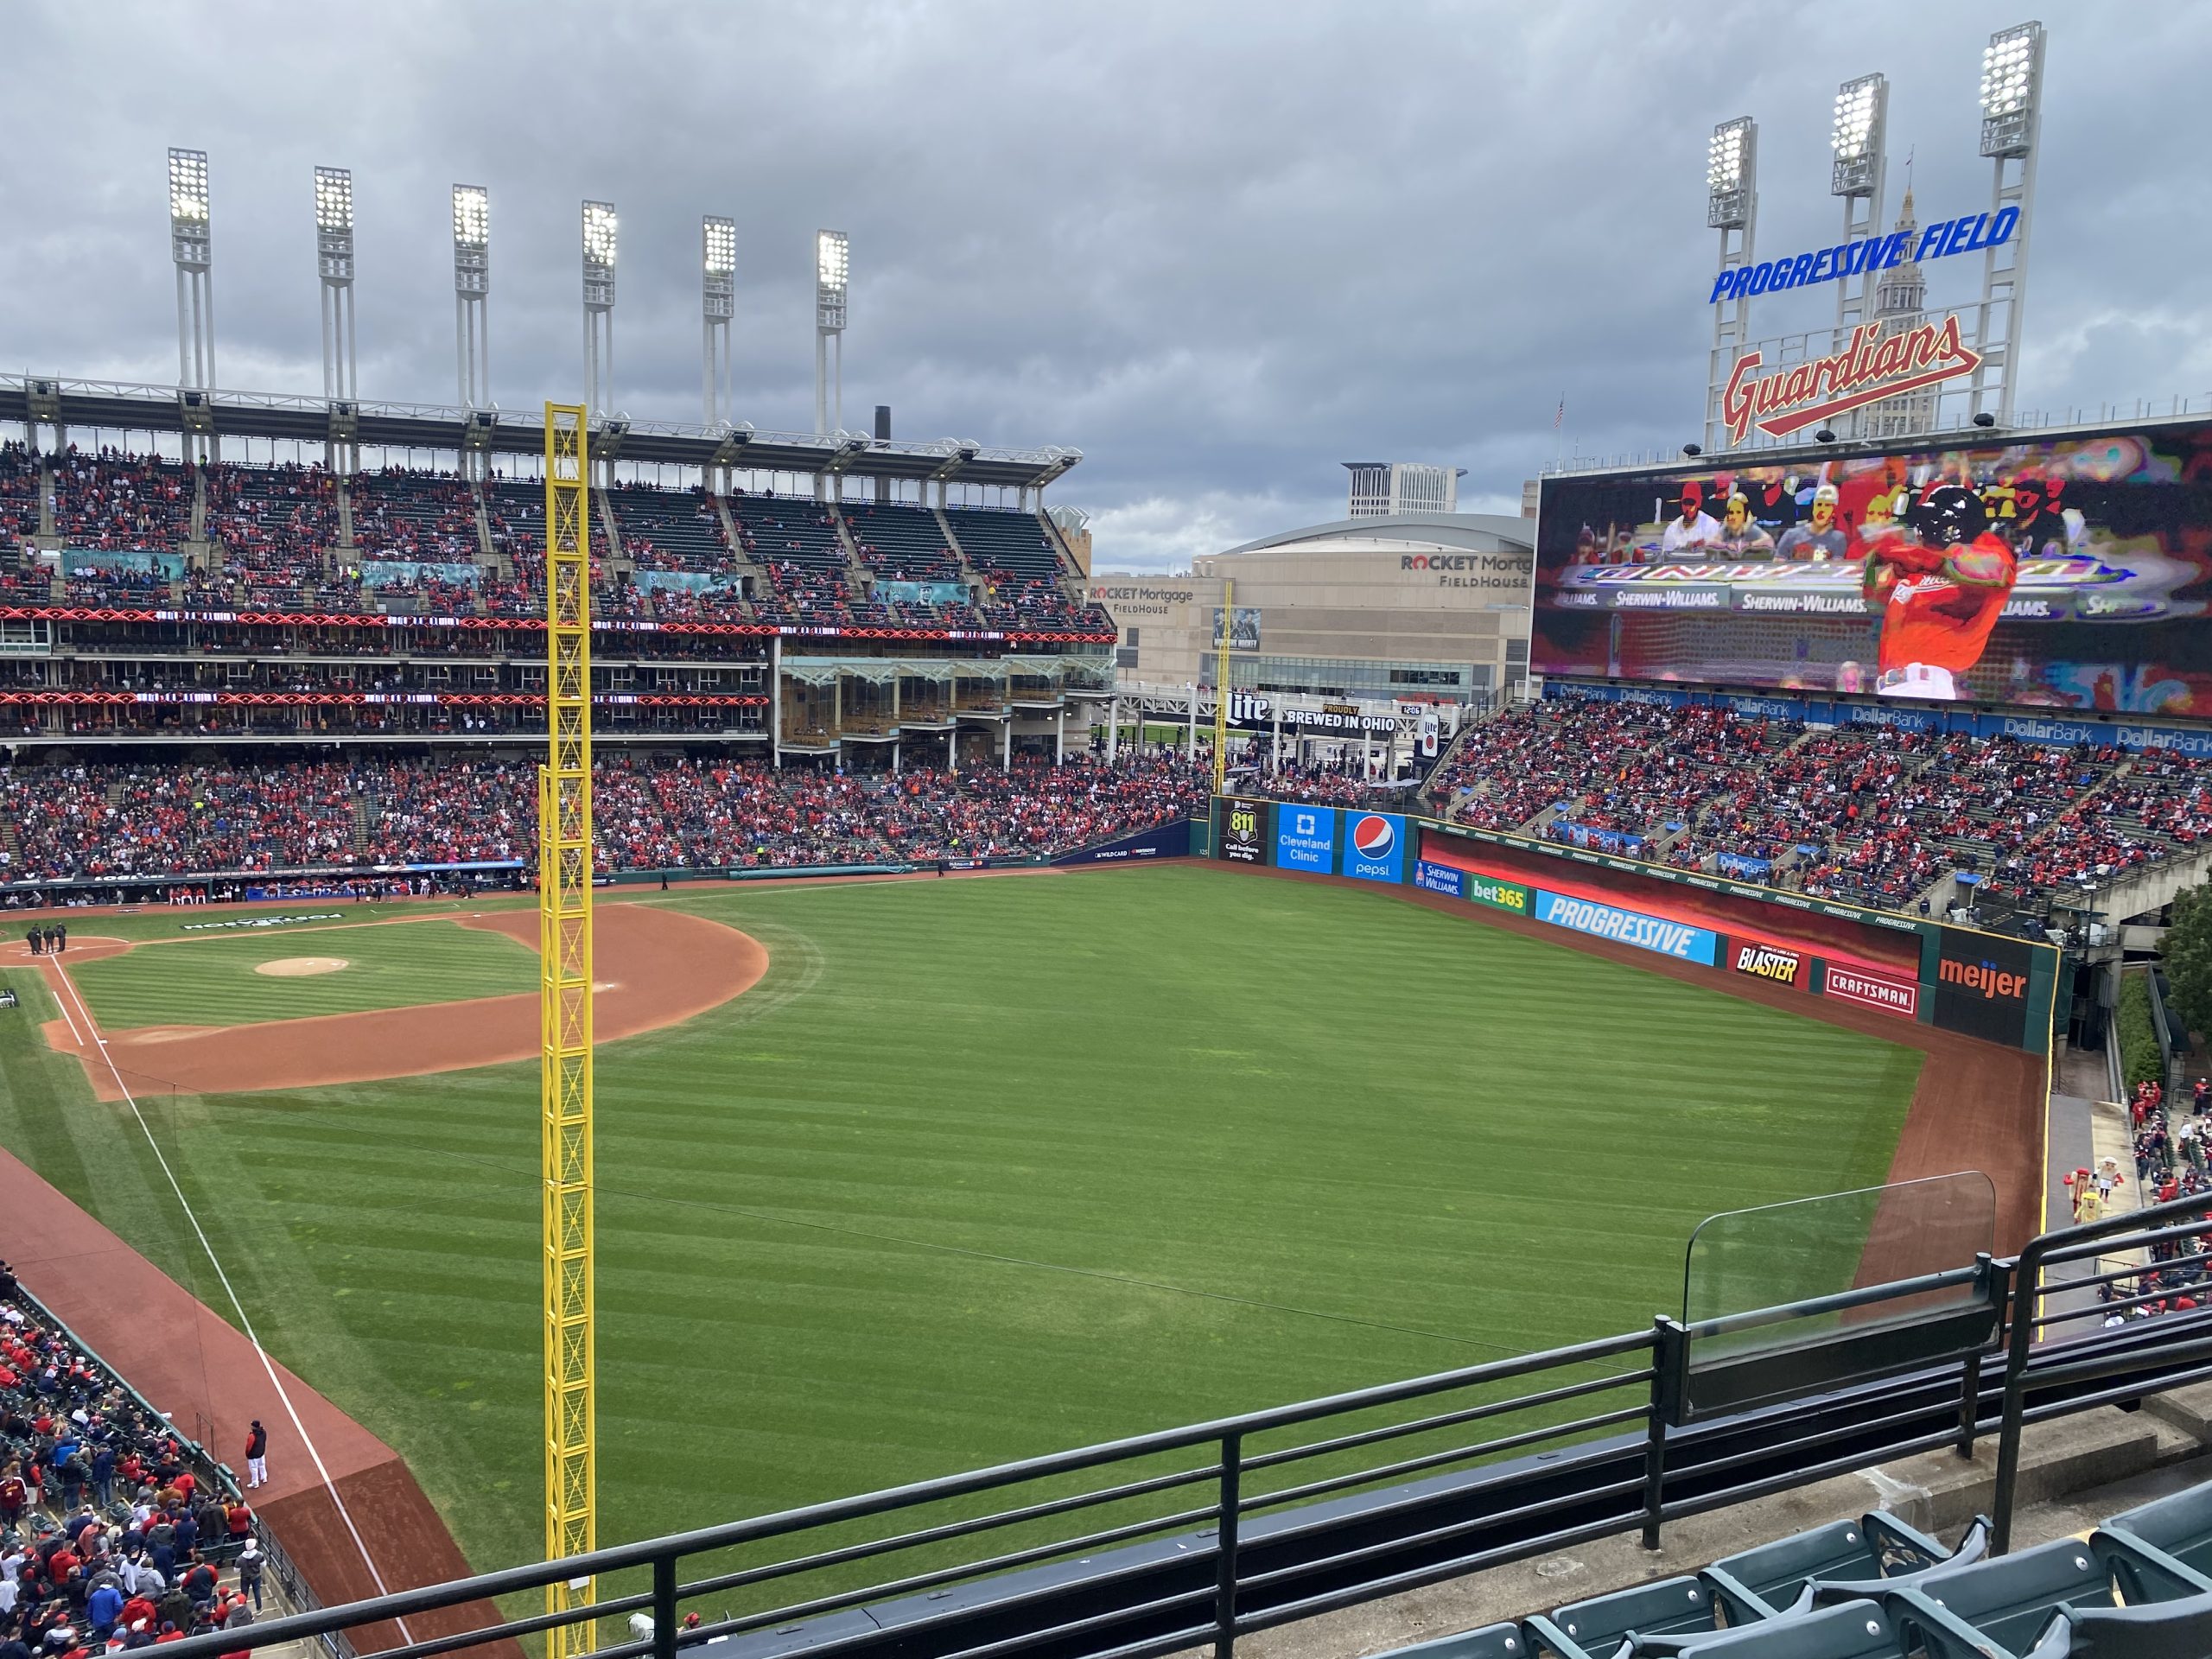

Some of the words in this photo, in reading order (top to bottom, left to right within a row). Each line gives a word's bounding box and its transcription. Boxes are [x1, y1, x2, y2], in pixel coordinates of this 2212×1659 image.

[1709, 230, 1913, 304] PROGRESSIVE
[1914, 206, 2020, 263] FIELD
[1722, 314, 1983, 446] Guardians
[1402, 555, 1478, 570] ROCKET
[1090, 587, 1138, 600] ROCKET
[1139, 588, 1193, 603] Mortgage
[1226, 692, 1269, 727] Lite
[1322, 703, 1360, 715] PROUDLY
[1728, 696, 1790, 716] DollarBank
[1287, 710, 1340, 728] BREWED
[1344, 715, 1360, 729] IN
[1362, 716, 1396, 732] OHIO
[1424, 715, 1438, 734] Lite
[1852, 706, 1924, 729] DollarBank
[2004, 718, 2093, 743] DollarBank
[1231, 811, 1255, 833] 811
[1237, 845, 1259, 854] before
[1280, 835, 1331, 850] Cleveland
[1538, 845, 1564, 855] PROGRESSIVE
[1290, 849, 1319, 863] Clinic
[1572, 852, 1599, 863] PROGRESSIVE
[1356, 863, 1389, 877] pepsi
[1427, 865, 1459, 883] SHERWIN
[1608, 860, 1637, 872] PROGRESSIVE
[1647, 868, 1678, 880] PROGRESSIVE
[1687, 876, 1719, 889] PROGRESSIVE
[1473, 880, 1524, 909] bet365
[1730, 885, 1764, 899] PROGRESSIVE
[1776, 895, 1812, 909] PROGRESSIVE
[1824, 906, 1863, 919] PROGRESSIVE
[1547, 897, 1696, 957] PROGRESSIVE
[1875, 916, 1916, 931] PROGRESSIVE
[1737, 947, 1798, 982] BLASTER
[1939, 959, 2026, 999] meijer
[1832, 974, 1909, 1007] CRAFTSMAN
